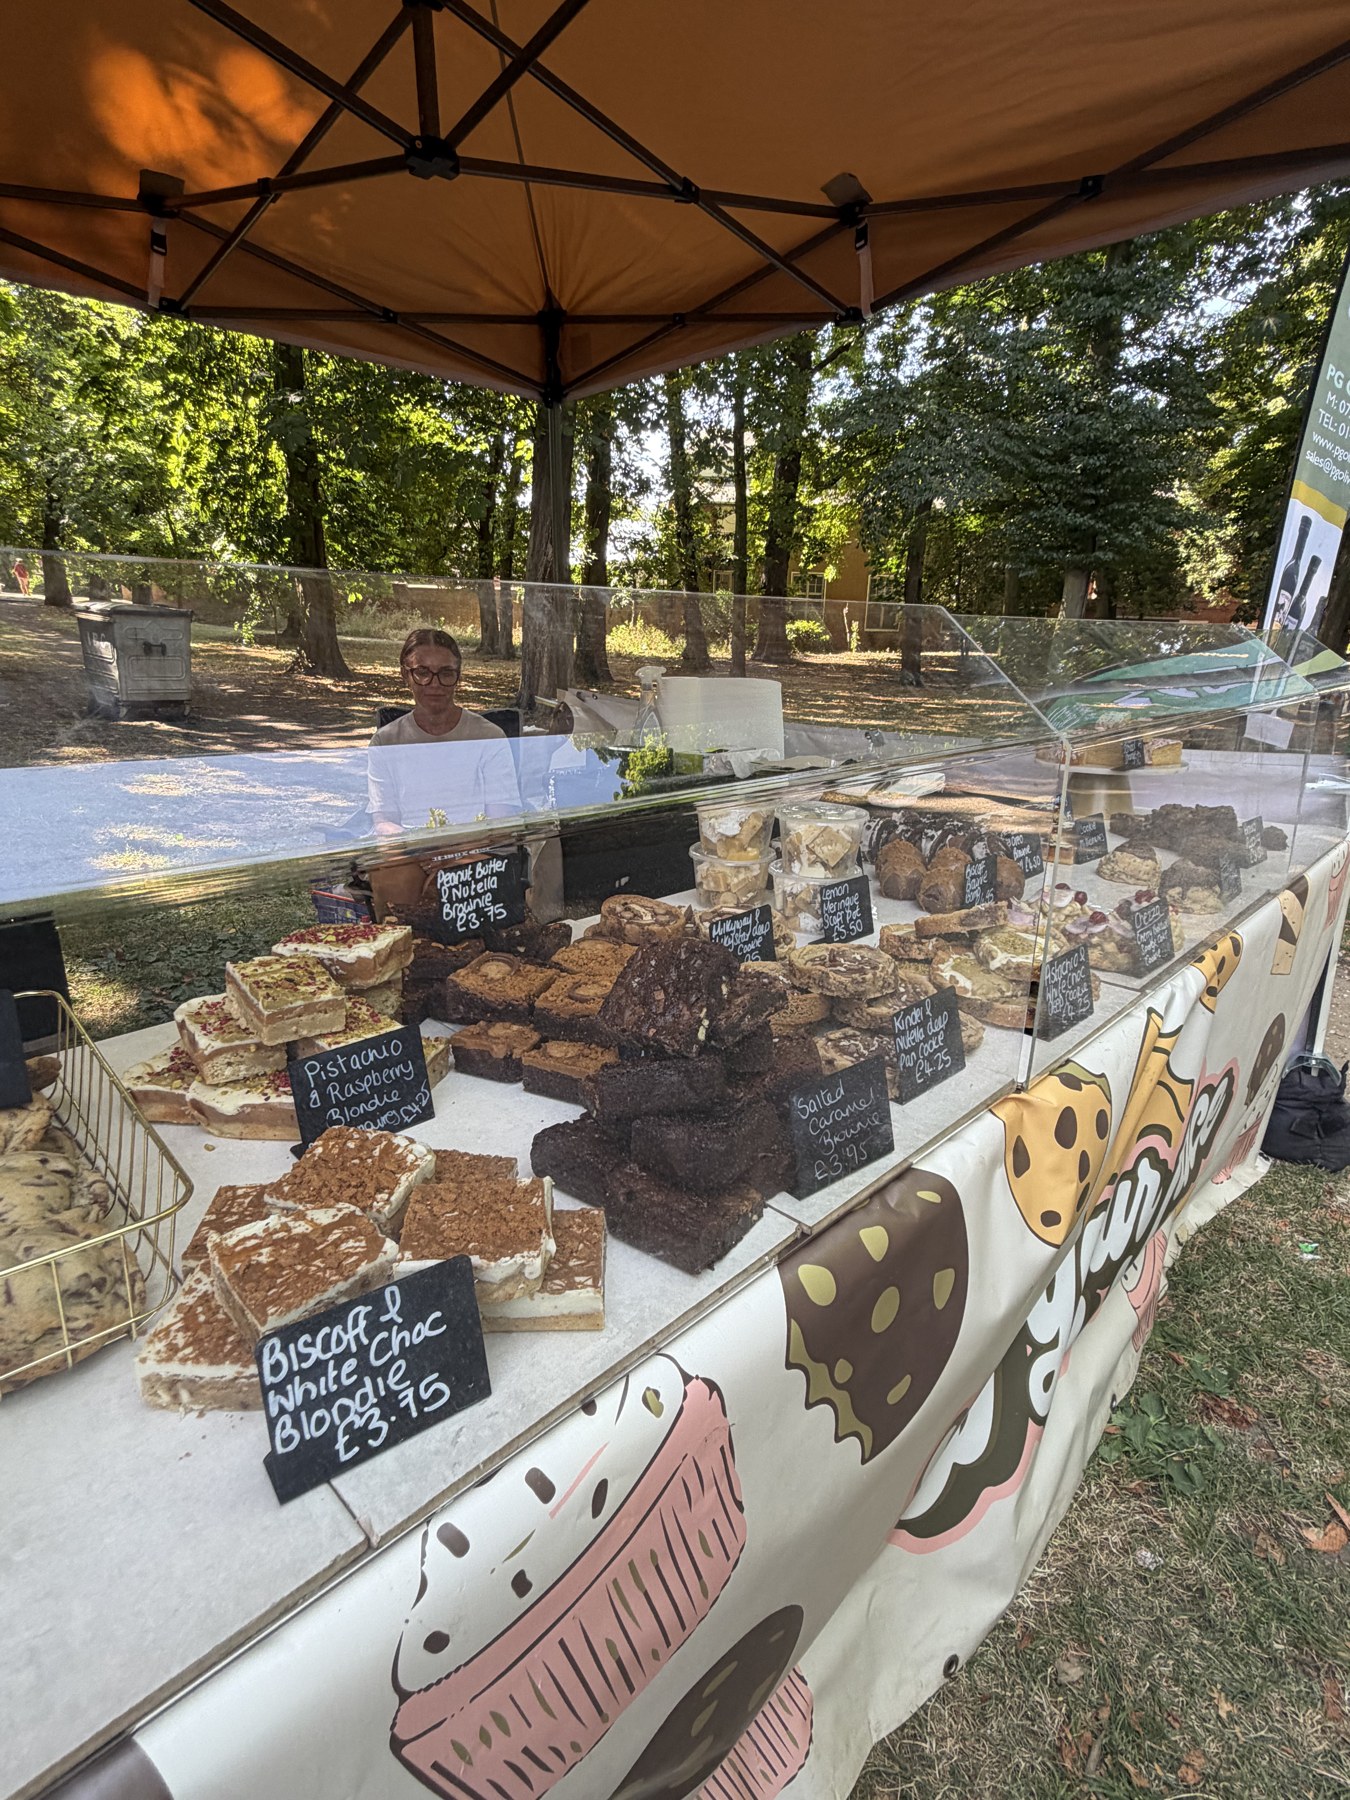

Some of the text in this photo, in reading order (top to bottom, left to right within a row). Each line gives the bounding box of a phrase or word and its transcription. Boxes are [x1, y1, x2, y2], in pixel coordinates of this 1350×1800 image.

[1326, 363, 1345, 389] PG
[1326, 391, 1338, 410] M:
[1319, 408, 1336, 432] TEL:
[436, 858, 509, 889] Peanut Butter
[451, 876, 498, 902] Nutella
[822, 883, 849, 900] Lemon
[442, 892, 493, 921] Brownie
[456, 902, 507, 933] £3.75
[823, 893, 860, 915] Meringue
[832, 918, 863, 942] £5.50
[893, 1006, 924, 1034] Kinder
[303, 1039, 403, 1089] Pistachio
[325, 1059, 415, 1105] Raspberry
[915, 1047, 952, 1084] £4.25
[325, 1089, 402, 1130] Blondie
[399, 1079, 431, 1124] £4.25
[797, 1078, 845, 1120] Salted
[808, 1086, 876, 1136] Caramel
[818, 1111, 884, 1156] Brownie
[262, 1305, 372, 1386] Biscoff
[267, 1310, 448, 1418] White Choc
[274, 1358, 411, 1455] Blondie
[334, 1372, 452, 1463] £3.75
